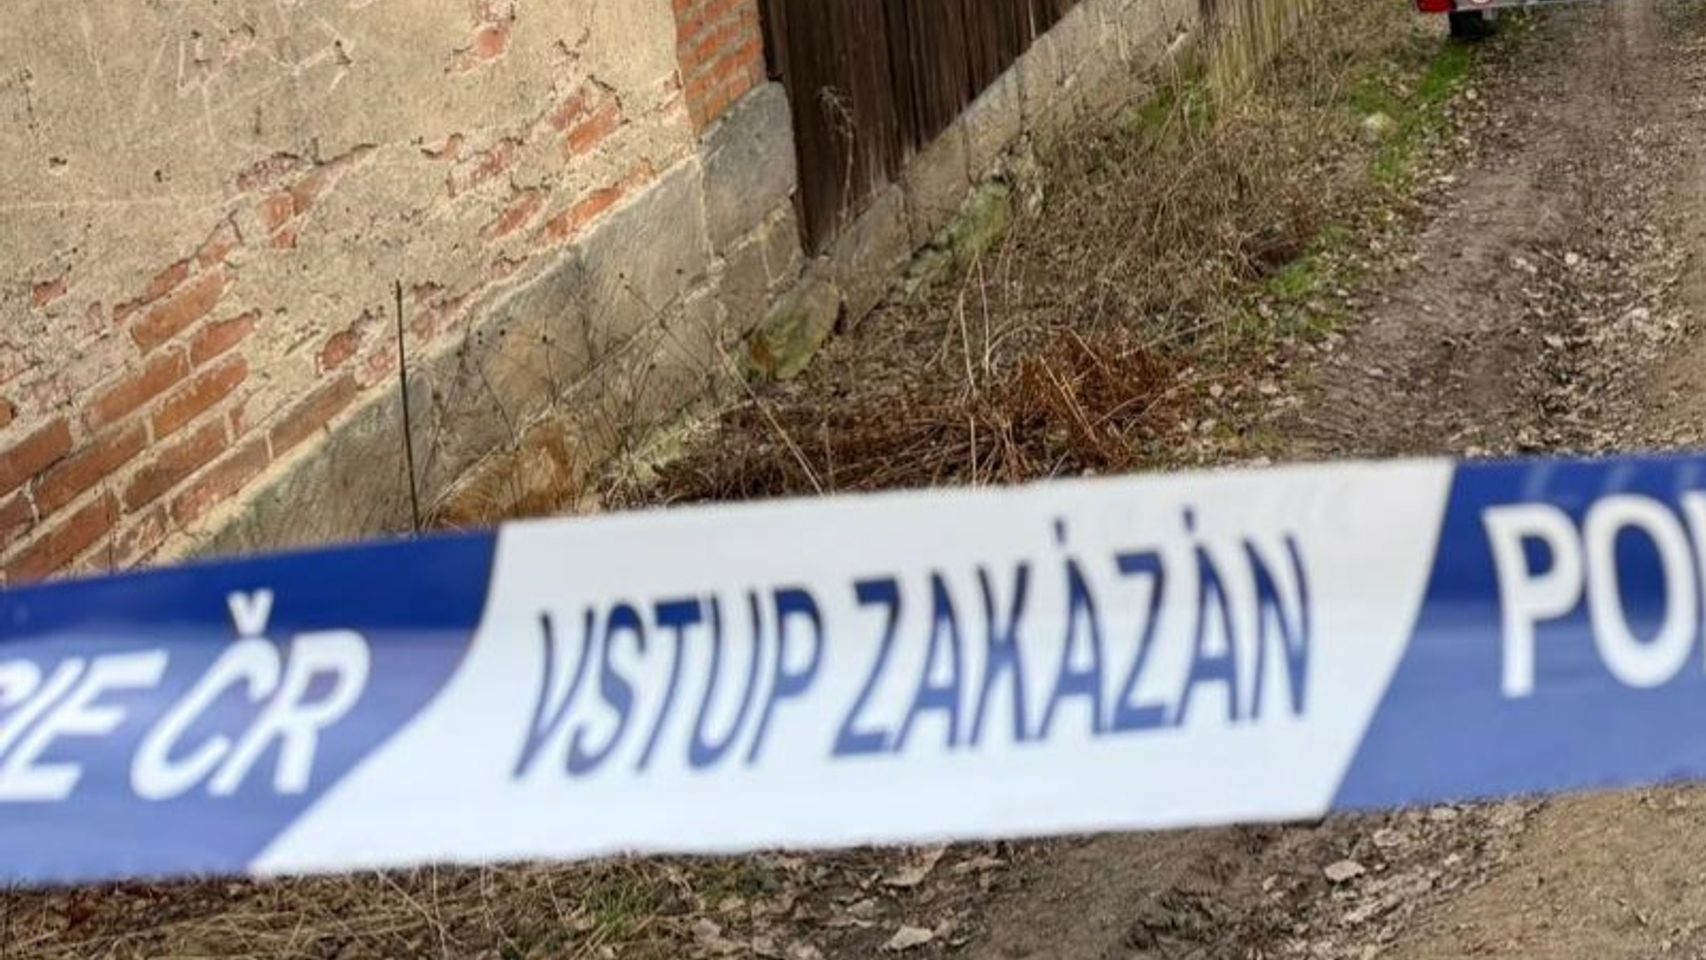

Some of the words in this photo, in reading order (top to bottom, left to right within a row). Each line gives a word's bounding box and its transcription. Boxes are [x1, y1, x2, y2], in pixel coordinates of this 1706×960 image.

[129, 587, 371, 801] ČR
[512, 584, 826, 779] VSTUP
[828, 504, 1313, 758] ZAKÁZÁN
